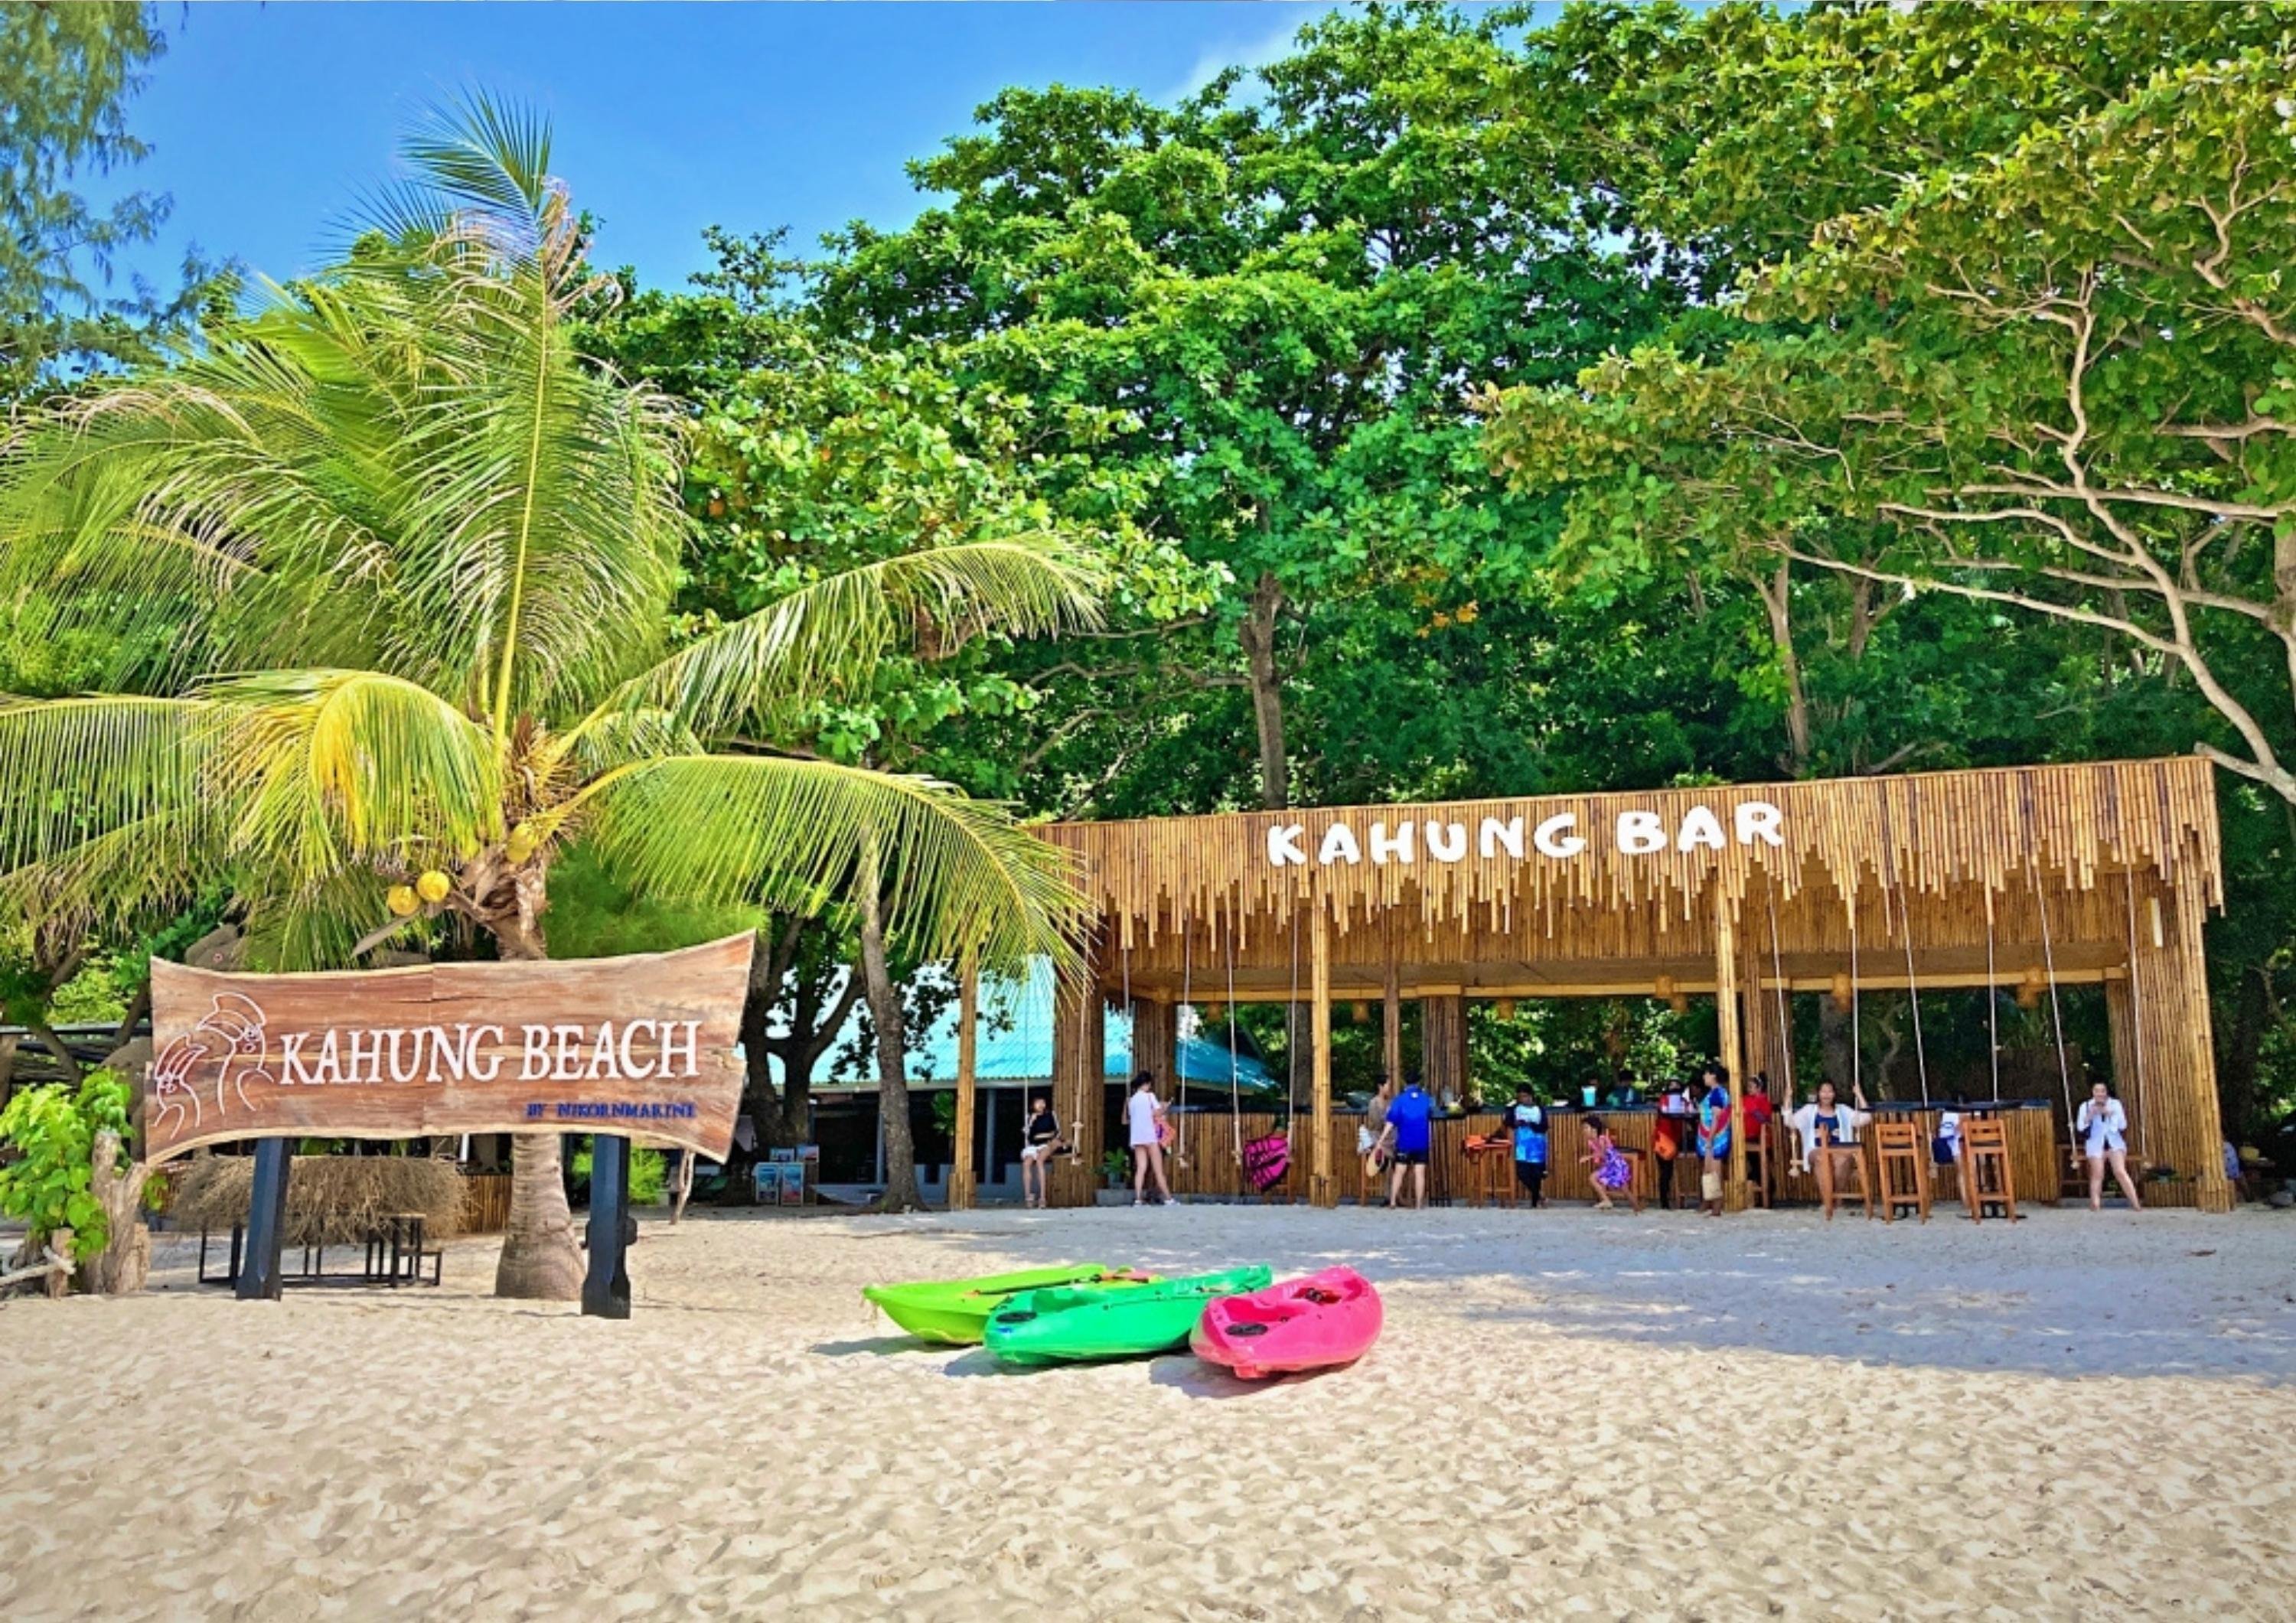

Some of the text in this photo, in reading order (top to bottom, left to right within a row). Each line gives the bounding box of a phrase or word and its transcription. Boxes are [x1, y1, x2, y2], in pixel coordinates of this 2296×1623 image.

[1267, 801, 1785, 866] KAHUNG BAR
[279, 1018, 703, 1084] KAHUNG BEACH
[527, 1103, 546, 1117] BY
